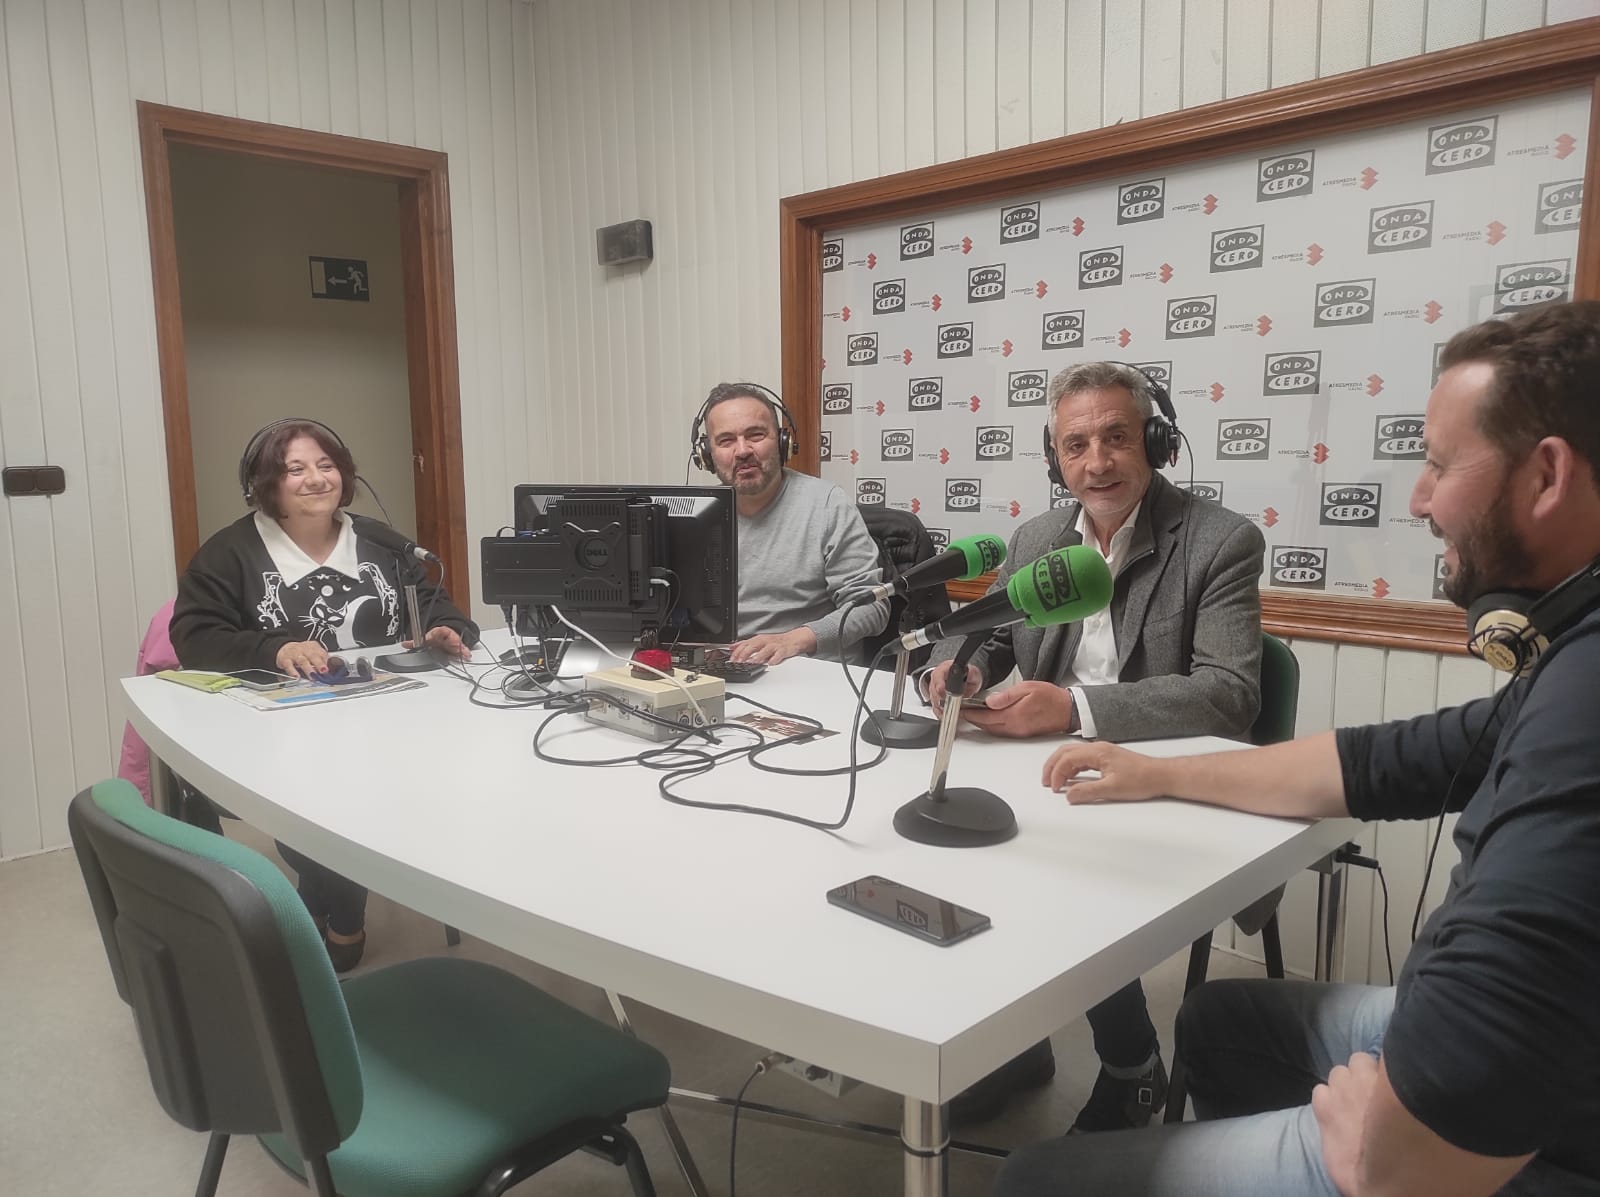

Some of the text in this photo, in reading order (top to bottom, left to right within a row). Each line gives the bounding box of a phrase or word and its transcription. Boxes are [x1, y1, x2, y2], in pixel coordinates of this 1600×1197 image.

[1438, 129, 1485, 146] ONDA
[1440, 147, 1483, 164] CERO
[1266, 162, 1305, 176] ONDA
[1267, 177, 1304, 192] CERO
[1124, 188, 1157, 201] ONDA
[1126, 203, 1156, 216] CERO
[1005, 211, 1034, 223] ONDA
[1379, 213, 1422, 227] ONDA
[905, 230, 930, 241] ONDA
[1007, 224, 1033, 236] CERO
[1219, 235, 1255, 248] ONDA
[1380, 229, 1421, 244] CERO
[903, 242, 929, 254] CERO
[824, 258, 839, 267] ERO
[1085, 255, 1117, 267] ONDA
[1220, 251, 1254, 263] CERO
[973, 272, 1000, 283] ONDA
[1087, 270, 1115, 281] CERO
[1507, 272, 1556, 284] ONDA
[877, 286, 901, 296] ONDA
[975, 285, 999, 295] CERO
[1323, 288, 1365, 302] ONDA
[1509, 289, 1555, 303] CERO
[878, 298, 900, 308] CERO
[1174, 305, 1209, 317] ONDA
[1325, 305, 1363, 317] CERO
[1048, 319, 1078, 329] ONDA
[1175, 320, 1208, 331] CERO
[942, 329, 968, 339] ONDA
[1050, 332, 1077, 342] CERO
[851, 339, 873, 349] ONDA
[944, 342, 967, 351] CERO
[852, 351, 873, 360] CERO
[1273, 360, 1312, 371] ONDA
[1013, 377, 1041, 387] ONDA
[1274, 375, 1310, 387] CERO
[826, 389, 848, 398] ONDA
[913, 383, 937, 393] ONDA
[1015, 390, 1041, 400] CERO
[827, 400, 848, 409] CERO
[914, 396, 937, 406] CERO
[981, 432, 1008, 442] ONDA
[1225, 426, 1261, 437] ONDA
[886, 434, 909, 444] ONDA
[886, 446, 908, 455] CERO
[982, 445, 1007, 455] CERO
[1227, 441, 1260, 452] CERO
[859, 484, 882, 493] ONDA
[950, 485, 976, 494] ONDA
[861, 494, 882, 503] CERO
[1331, 490, 1370, 502] ONDA
[951, 497, 976, 507] CERO
[1332, 507, 1369, 518] CERO
[586, 548, 608, 556] DELL
[1279, 555, 1318, 565] ONDA
[1038, 561, 1054, 600] CERO
[1052, 555, 1069, 596] ONDA
[1281, 570, 1316, 581] CERO
